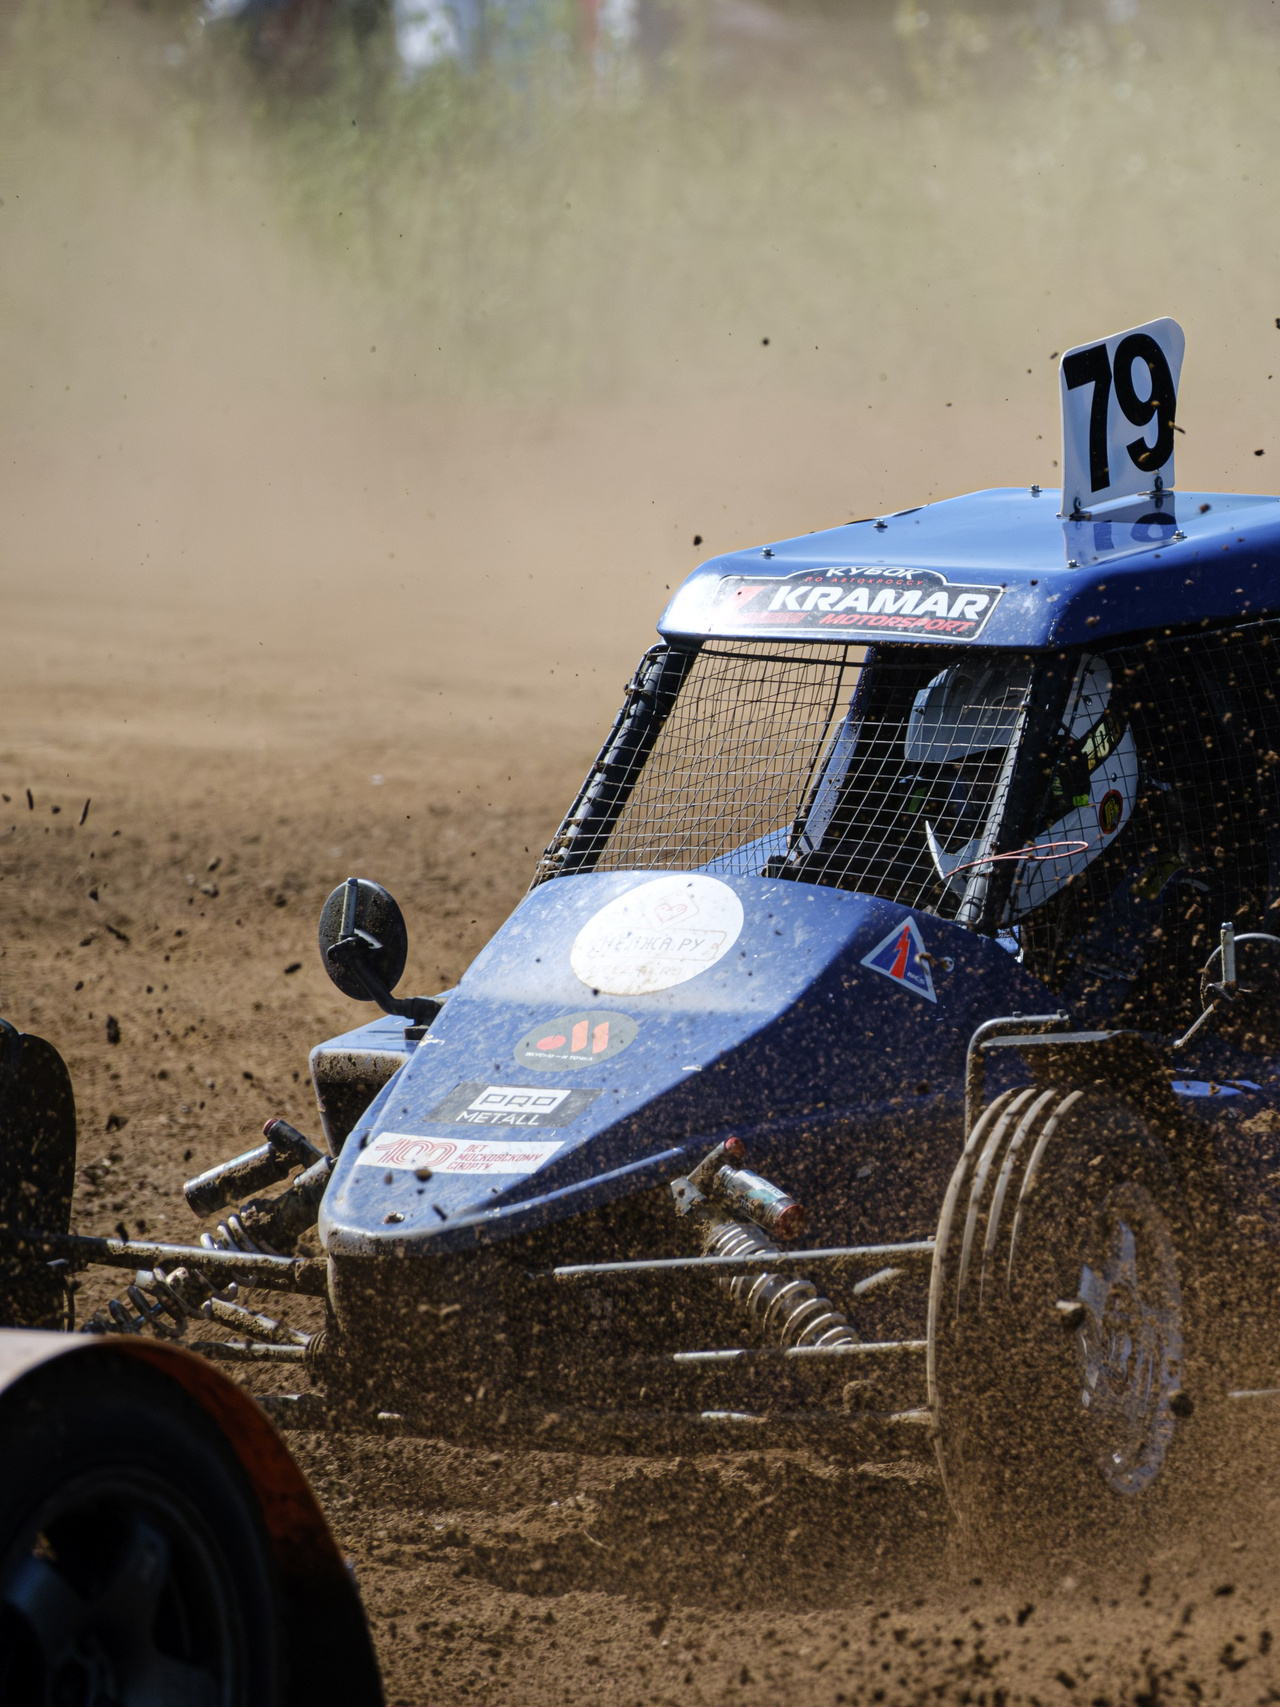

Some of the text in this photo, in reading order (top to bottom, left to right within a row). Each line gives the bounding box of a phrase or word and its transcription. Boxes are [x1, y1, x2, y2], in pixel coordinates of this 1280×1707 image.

[1063, 333, 1176, 493] 79
[826, 567, 923, 580] КУБОК
[831, 577, 924, 586] АВТОКРОССУ
[767, 585, 989, 620] KRAMAR
[818, 613, 977, 633] MOTORSPORT
[478, 1093, 559, 1107] PRO
[455, 1111, 540, 1126] METALL
[375, 1138, 457, 1168] 100
[463, 1144, 488, 1153] ЛЕТ
[457, 1152, 543, 1162] МОСКОВСКОМУ
[446, 1161, 493, 1171] СПОРТУ
